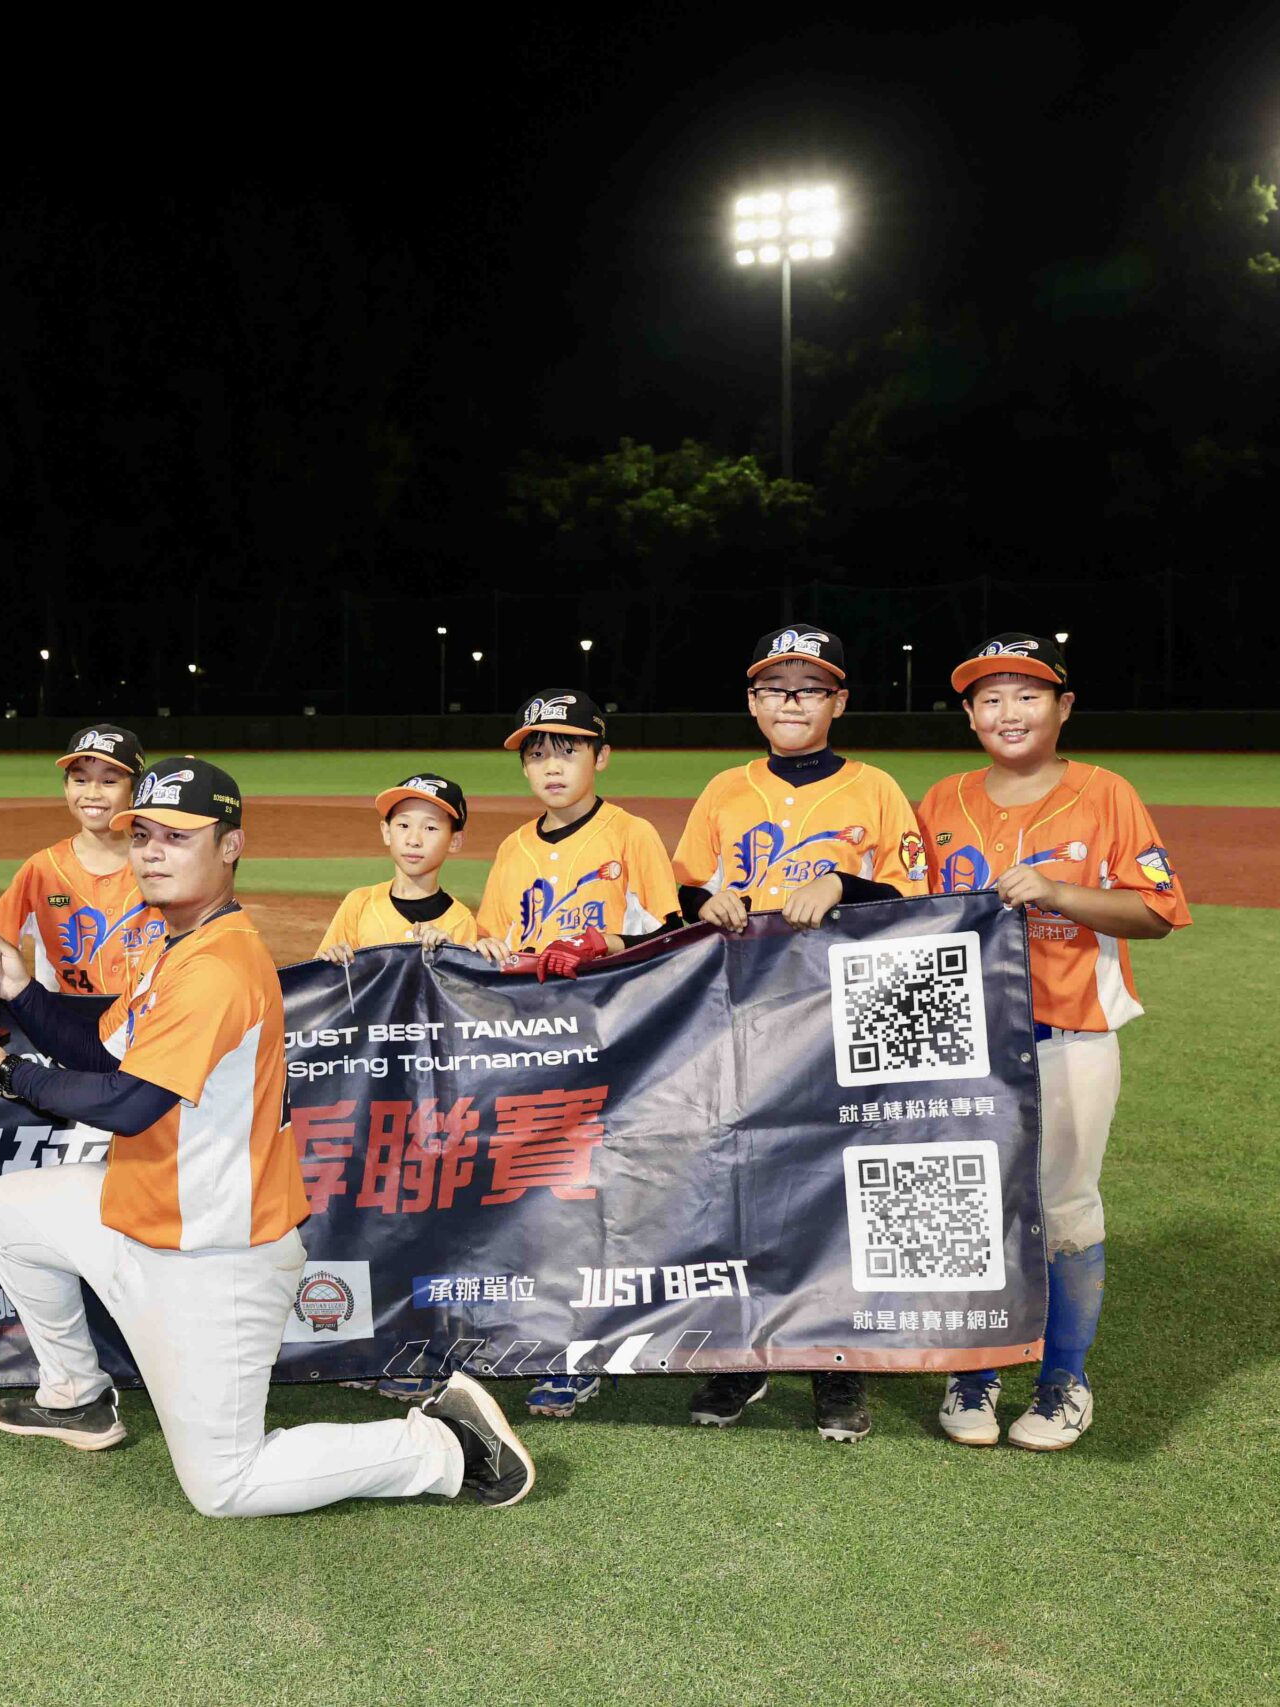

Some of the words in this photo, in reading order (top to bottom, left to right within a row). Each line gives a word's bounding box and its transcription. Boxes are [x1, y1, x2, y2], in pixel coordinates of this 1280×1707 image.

[1028, 925, 1079, 940] 湖社區
[62, 969, 94, 993] 54
[283, 1027, 358, 1049] JUST
[368, 1023, 444, 1042] BEST
[455, 1016, 578, 1040] TAIWAN
[287, 1054, 389, 1082] Spring
[398, 1044, 598, 1073] Tournament
[838, 1096, 996, 1124] 就是棒粉絲專頁
[427, 1275, 537, 1303] 承辦單位
[569, 1266, 655, 1308] JUST
[661, 1260, 751, 1300] BEST
[852, 1309, 1009, 1331] 就是棒賽事網站
